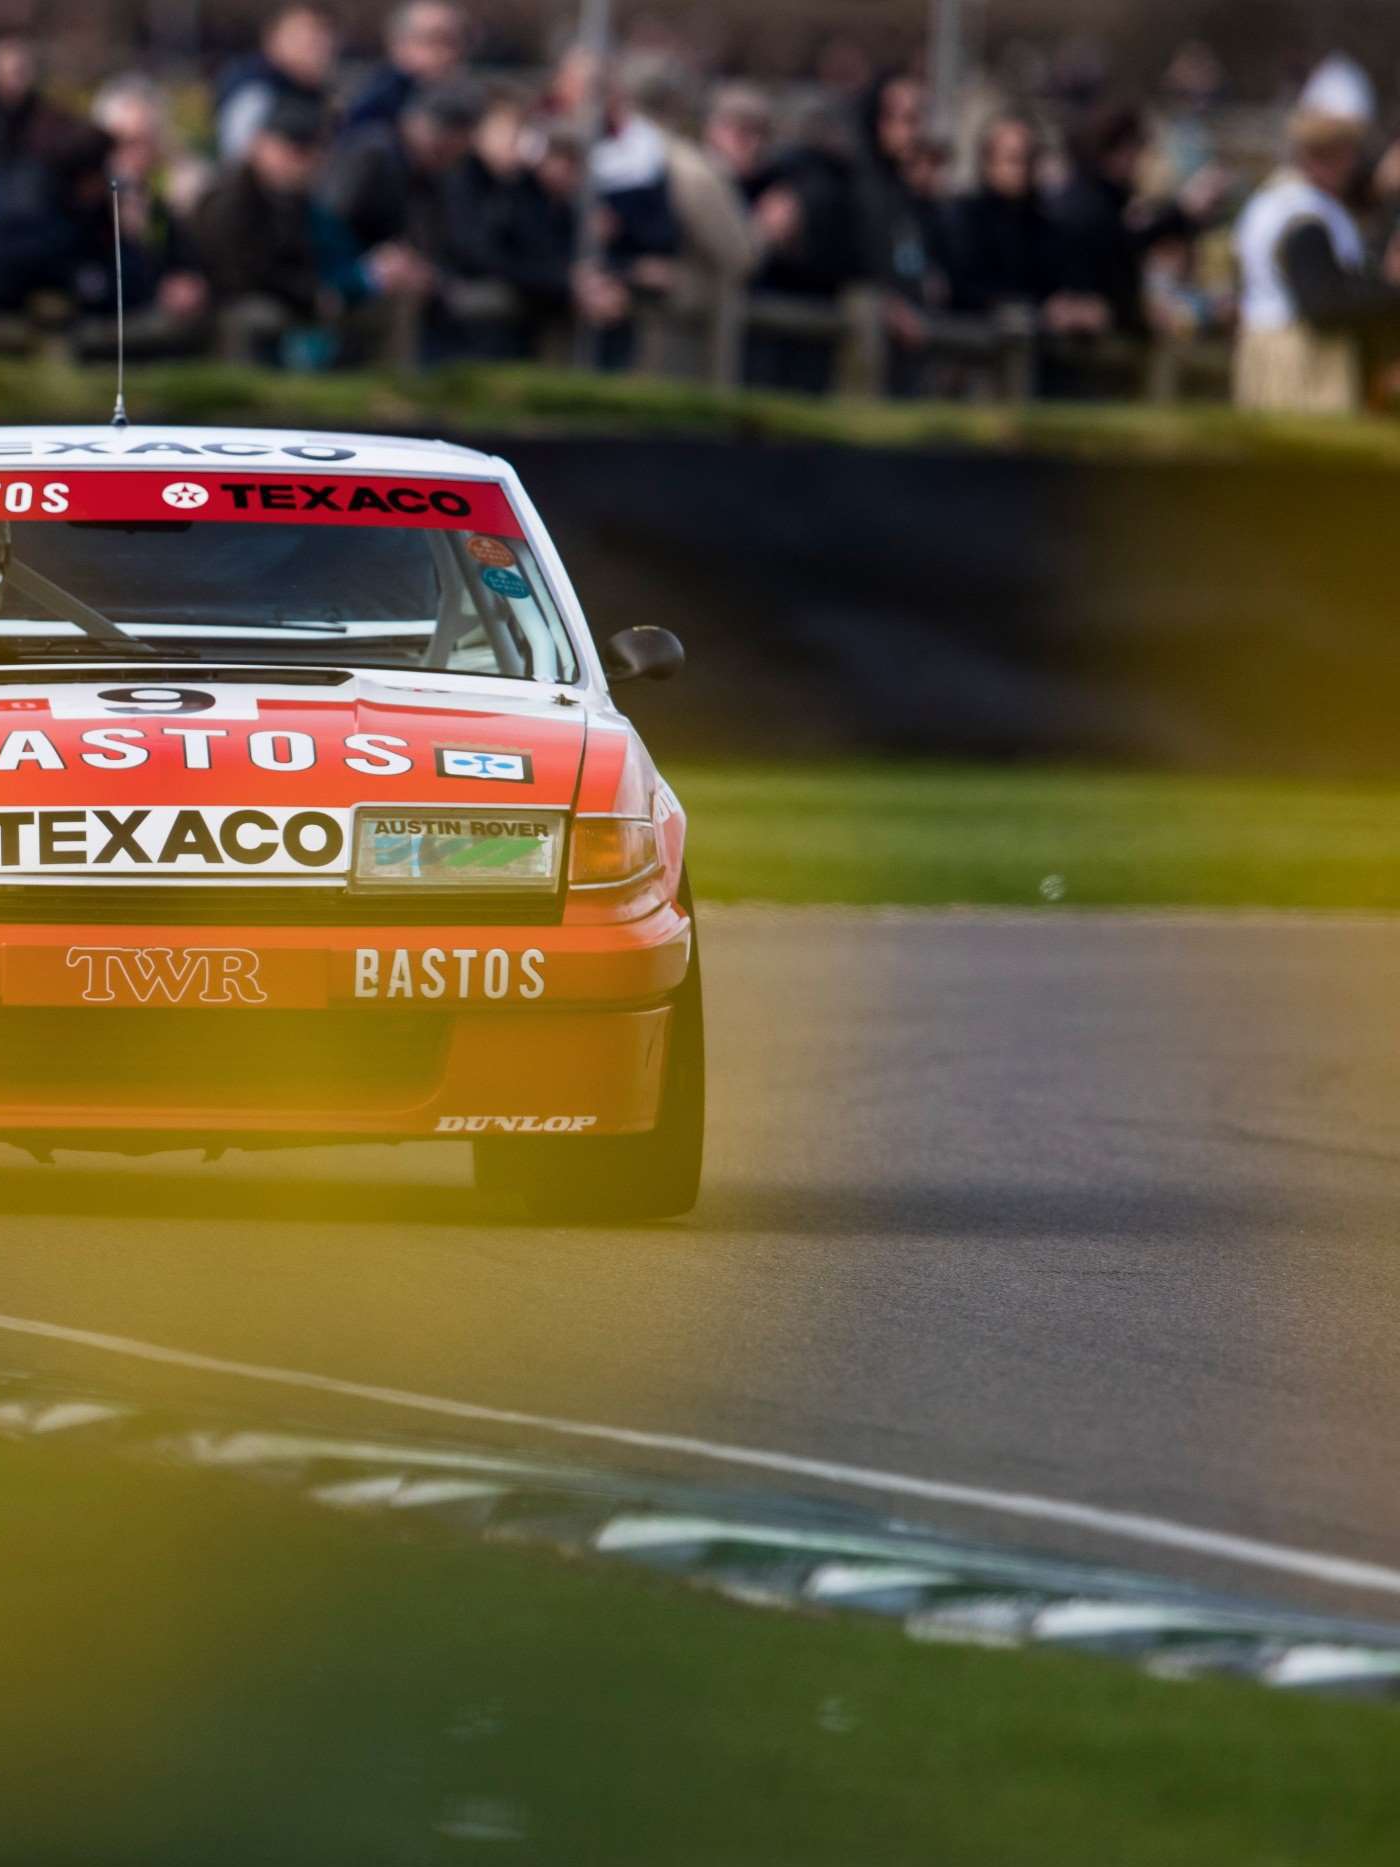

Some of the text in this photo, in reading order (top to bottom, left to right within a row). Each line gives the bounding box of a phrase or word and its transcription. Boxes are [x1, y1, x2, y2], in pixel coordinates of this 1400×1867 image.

[220, 482, 472, 518] TEXACO
[97, 687, 216, 714] 9
[374, 819, 550, 838] AUSTIN ROVER
[65, 946, 268, 1001] TWR
[354, 947, 546, 1000] BASTOS
[434, 1115, 598, 1132] DUNLOP
